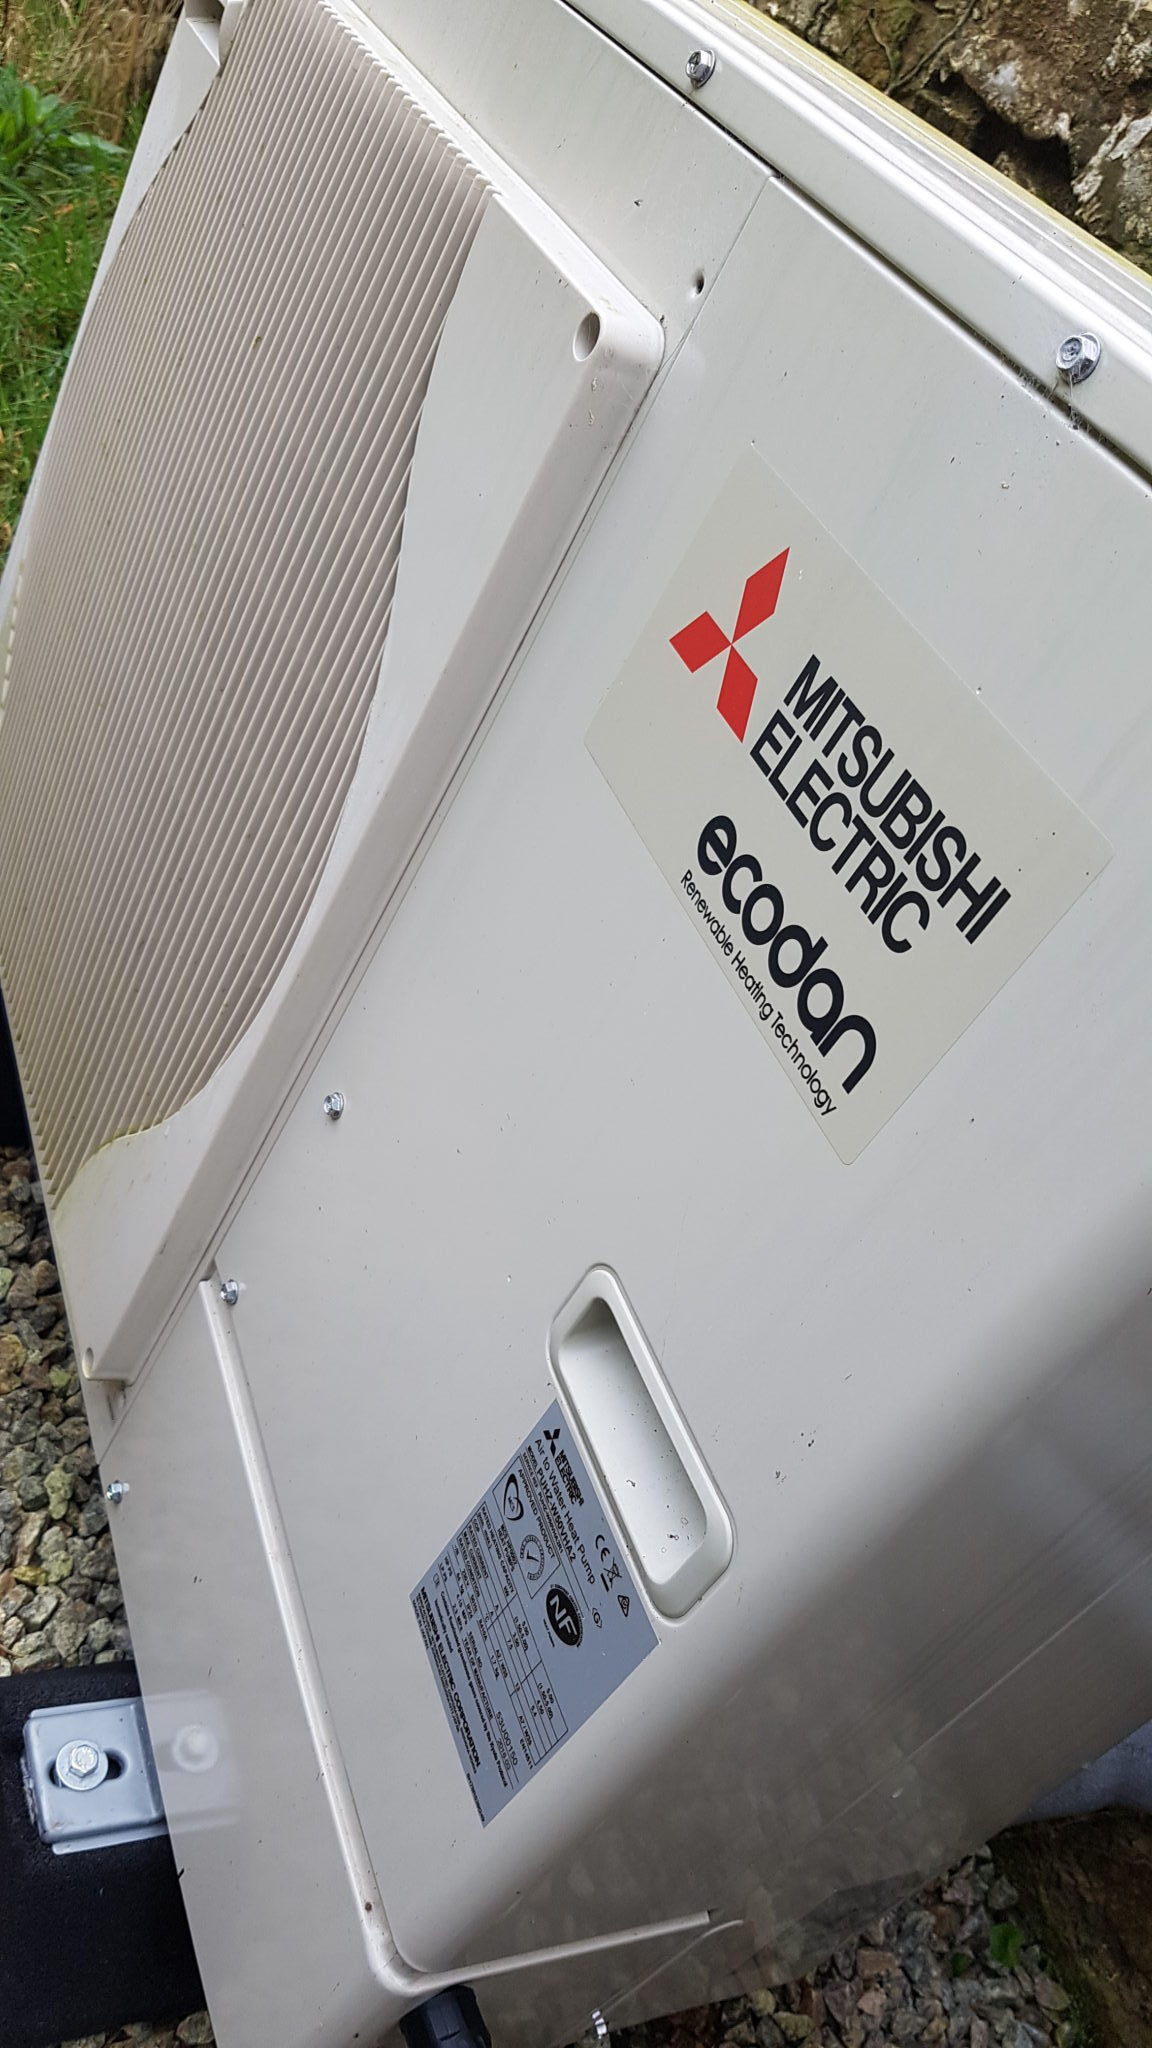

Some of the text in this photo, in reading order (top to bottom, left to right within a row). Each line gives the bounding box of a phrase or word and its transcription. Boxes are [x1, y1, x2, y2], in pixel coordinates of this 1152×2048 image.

[750, 709, 930, 954] ELECTRIC
[783, 654, 1012, 944] MITSUBISHI
[680, 869, 837, 1117] Renewable Heating Technology
[697, 815, 877, 1094] ecodan
[518, 1469, 538, 1515] APPROVED
[536, 1516, 555, 1558] PRODUCT
[535, 1439, 595, 1584] Air to Water Heat Pump
[537, 1467, 576, 1562] PUHZ-W50VHA2
[555, 1455, 577, 1504] ELECTRIC
[559, 1449, 584, 1506] MITSUBISHI
[468, 1525, 477, 1547] RATED
[476, 1548, 489, 1579] CURRENT
[469, 1548, 482, 1579] CURRENT
[482, 1506, 514, 1593] RATED HEATING CAPACITY
[549, 1594, 578, 1636] NF
[421, 1586, 440, 1642] MITSUBISHI
[438, 1642, 456, 1691] ELECTRIC
[454, 1692, 480, 1767] CORPORATION
